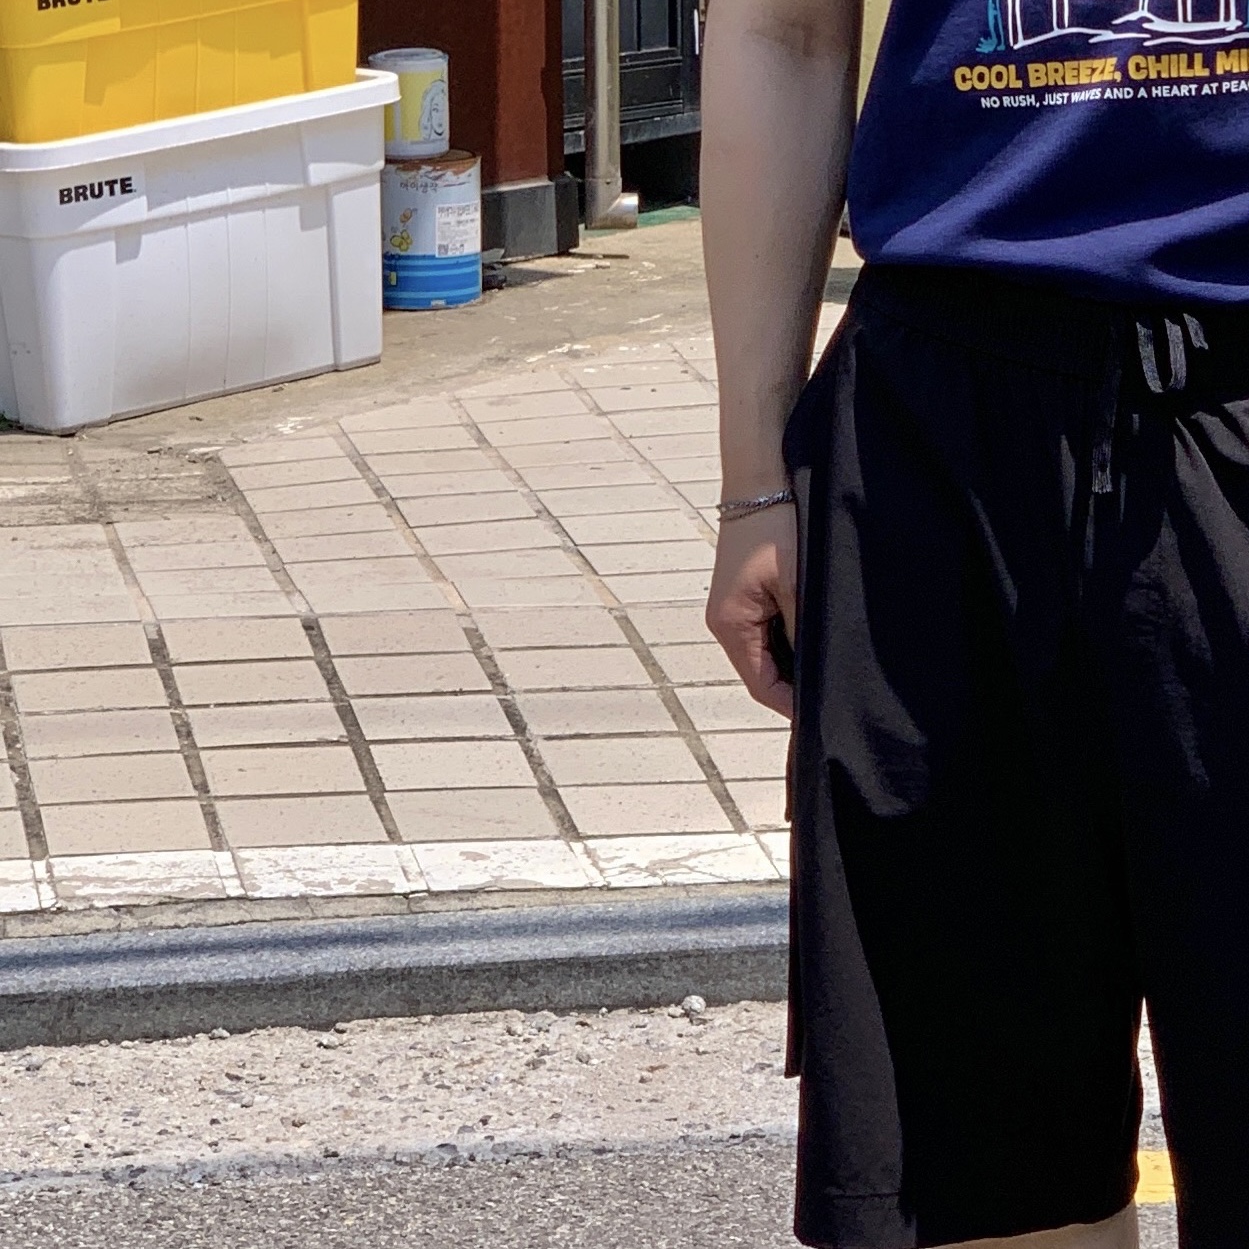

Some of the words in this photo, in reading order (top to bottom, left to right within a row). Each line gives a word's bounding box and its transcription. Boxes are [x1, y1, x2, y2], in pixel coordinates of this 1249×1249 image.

[954, 64, 1022, 91] COOL
[1027, 56, 1122, 88] BREEZE,
[1127, 52, 1210, 81] CHILL
[980, 96, 1000, 109] NO
[1002, 93, 1040, 108] RUSH,
[1042, 92, 1070, 106] JUST
[1070, 88, 1102, 103] WAVES
[1104, 86, 1133, 99] AND
[1137, 86, 1149, 99] A
[1152, 83, 1198, 97] HEART
[1201, 82, 1218, 95] AT
[58, 176, 135, 206] BRUTE
